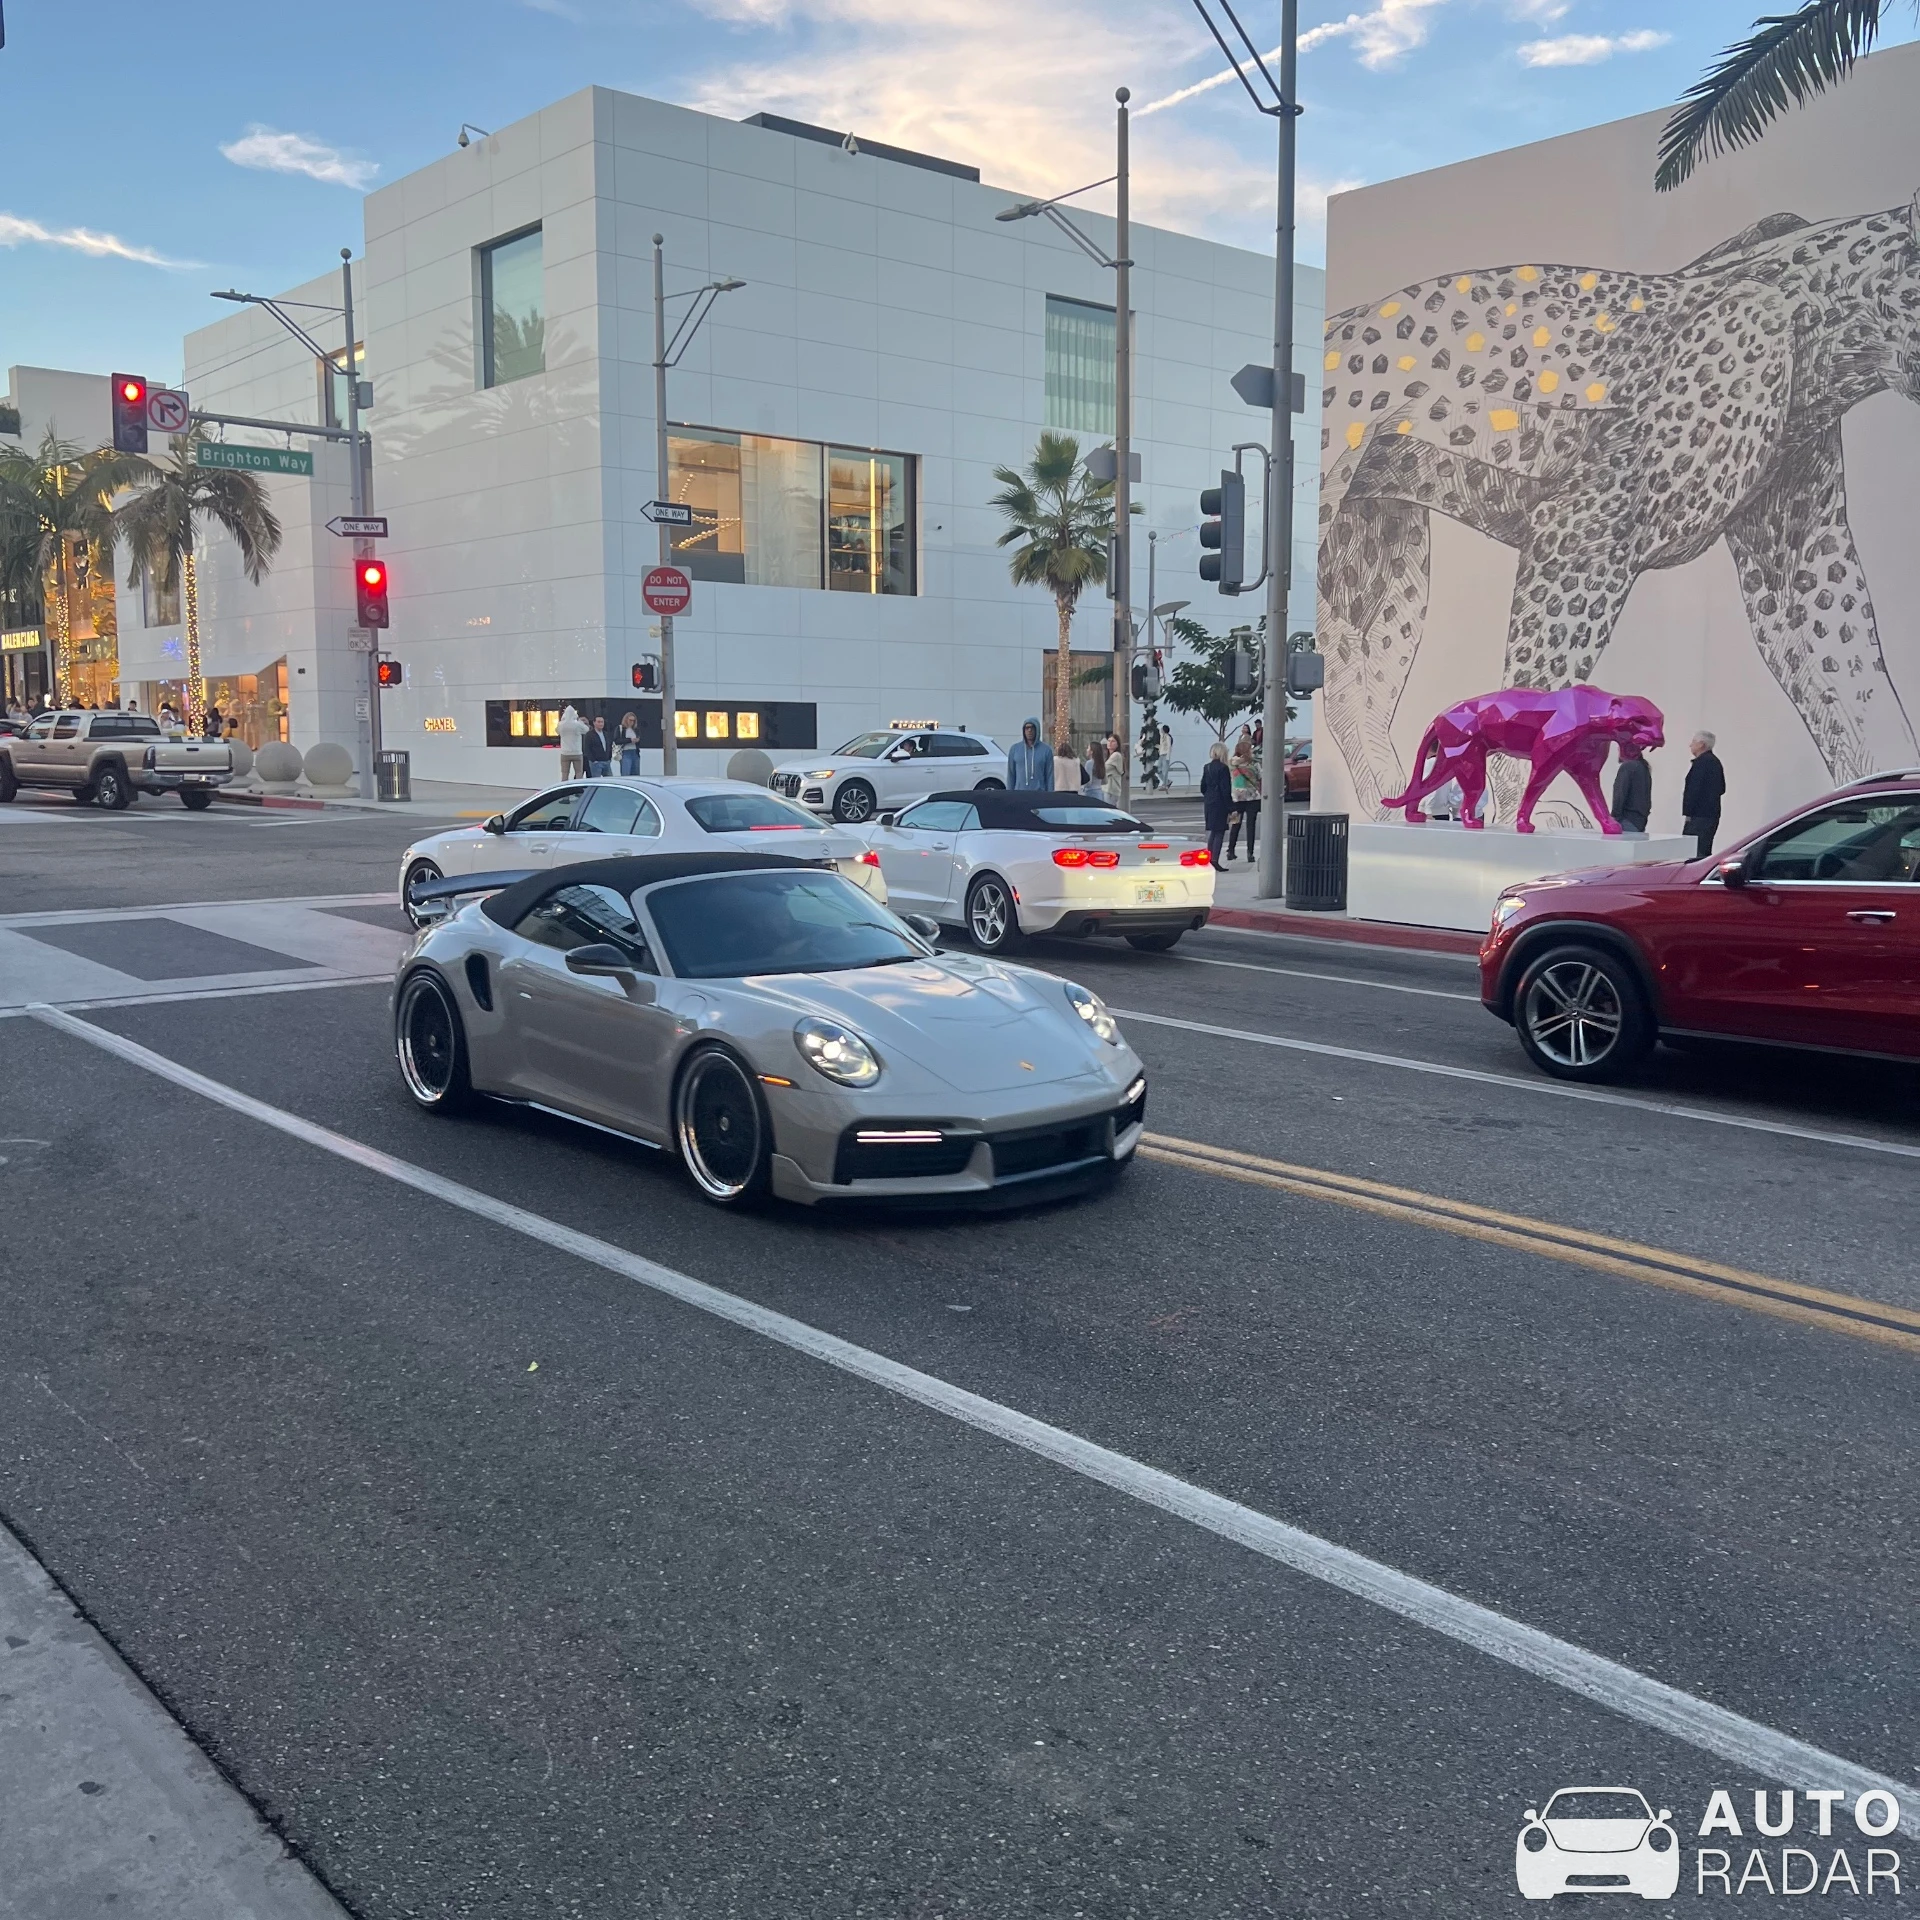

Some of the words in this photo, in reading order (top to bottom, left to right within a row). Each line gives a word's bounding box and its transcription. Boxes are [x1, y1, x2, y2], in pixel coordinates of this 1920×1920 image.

[202, 447, 271, 467] Brighton
[278, 454, 307, 472] Way
[655, 508, 669, 517] ONE
[671, 509, 685, 518] WAY
[343, 522, 360, 531] ONE
[363, 523, 380, 531] WAY
[650, 575, 661, 584] DO
[666, 576, 682, 585] NOT
[653, 597, 680, 607] ENTER
[1, 630, 40, 650] BALENCIAGA
[350, 640, 359, 649] OK
[424, 717, 456, 731] CHANEL
